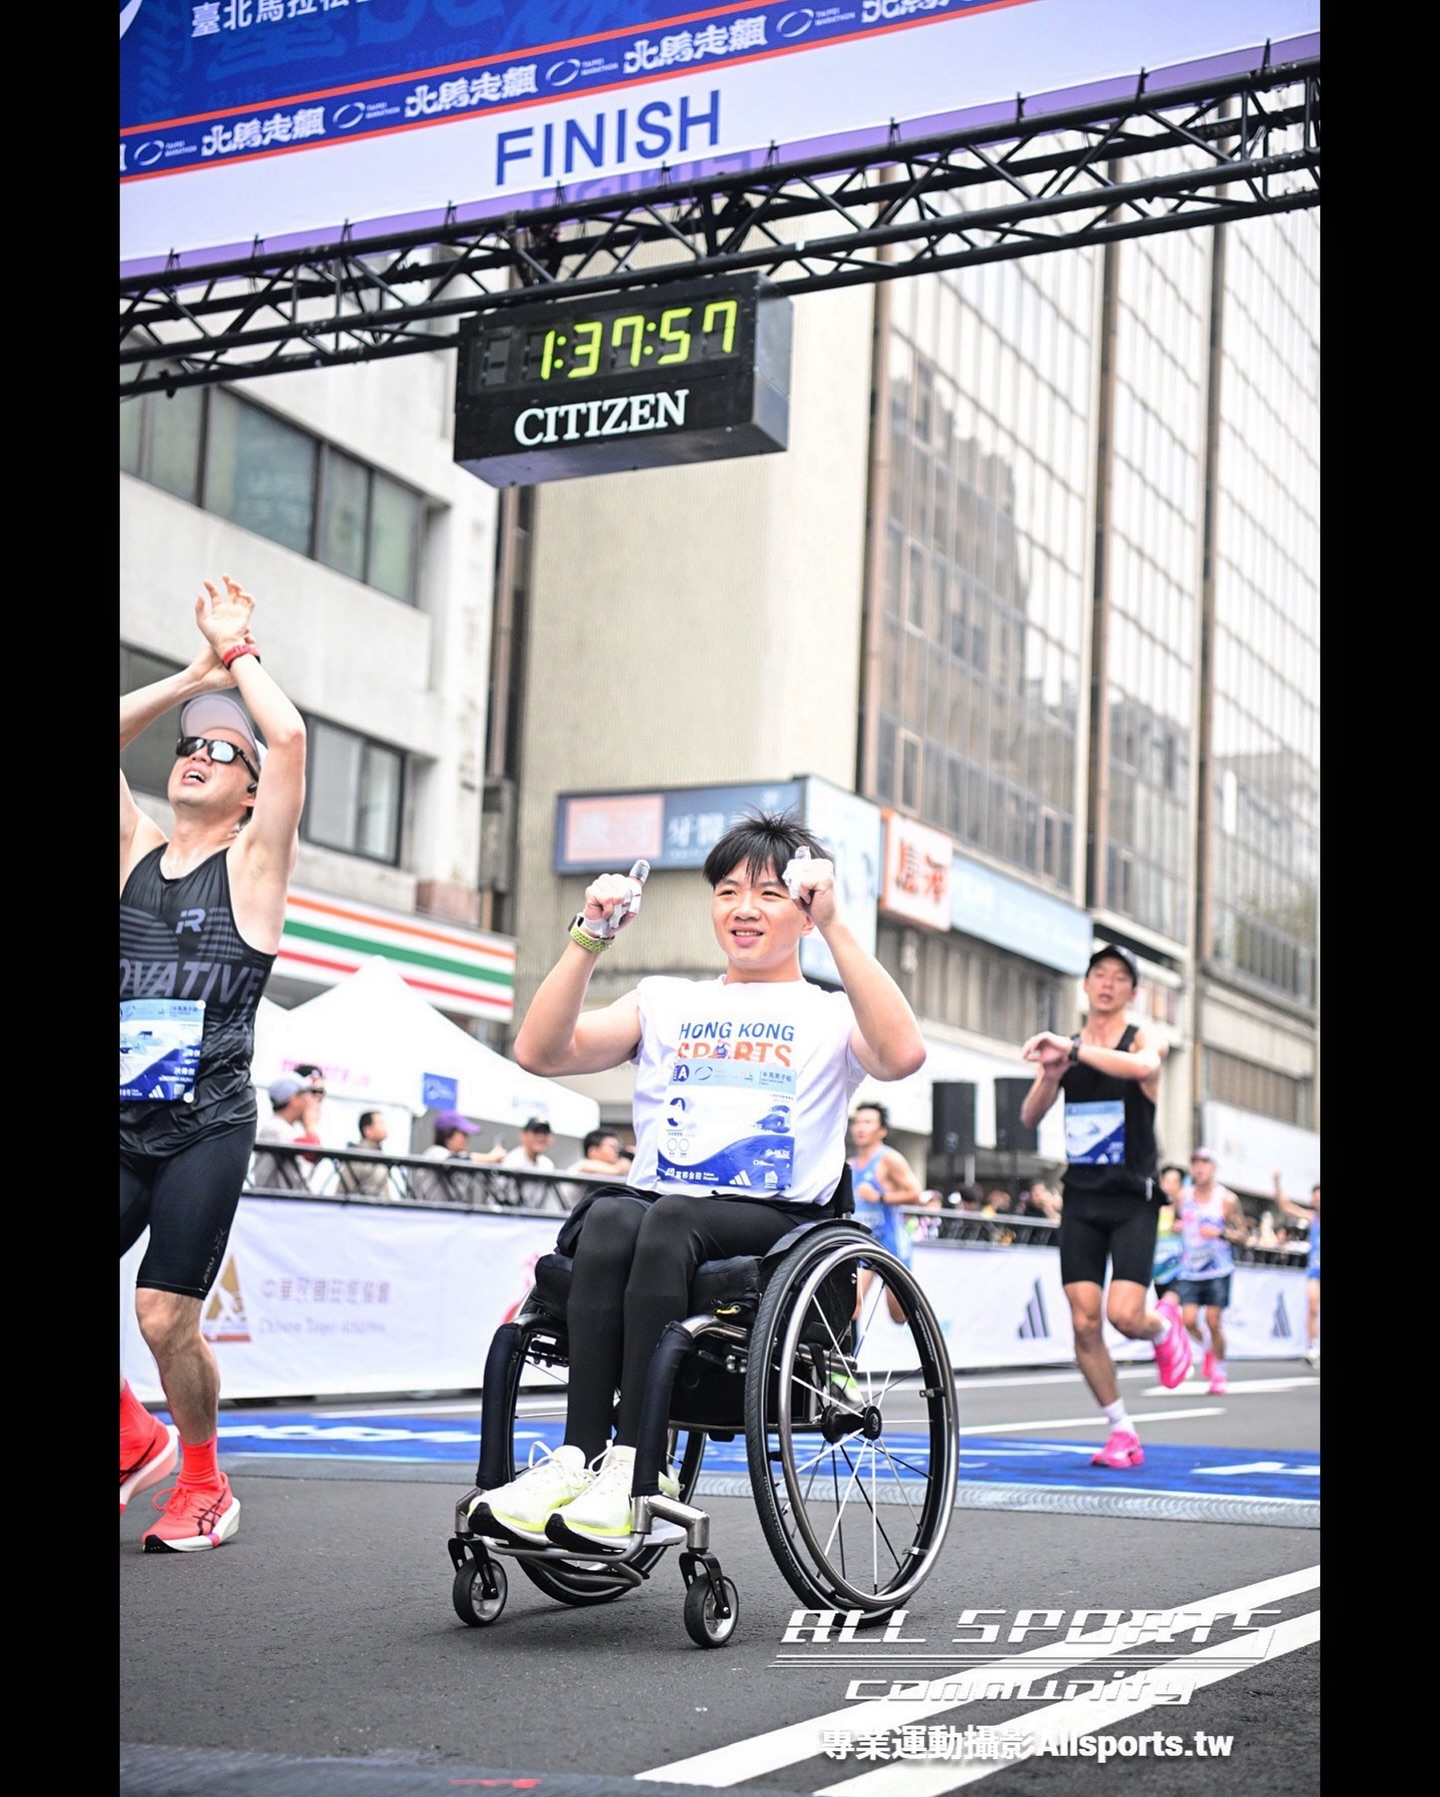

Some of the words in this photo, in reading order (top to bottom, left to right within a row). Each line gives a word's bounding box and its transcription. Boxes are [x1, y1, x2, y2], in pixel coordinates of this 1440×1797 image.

[191, 0, 371, 37] 臺北馬拉
[496, 89, 722, 187] FINISH
[540, 300, 738, 381] 1:37:57
[513, 389, 690, 446] CITIZEN
[679, 1021, 733, 1040] HONG
[738, 1022, 795, 1041] KONG
